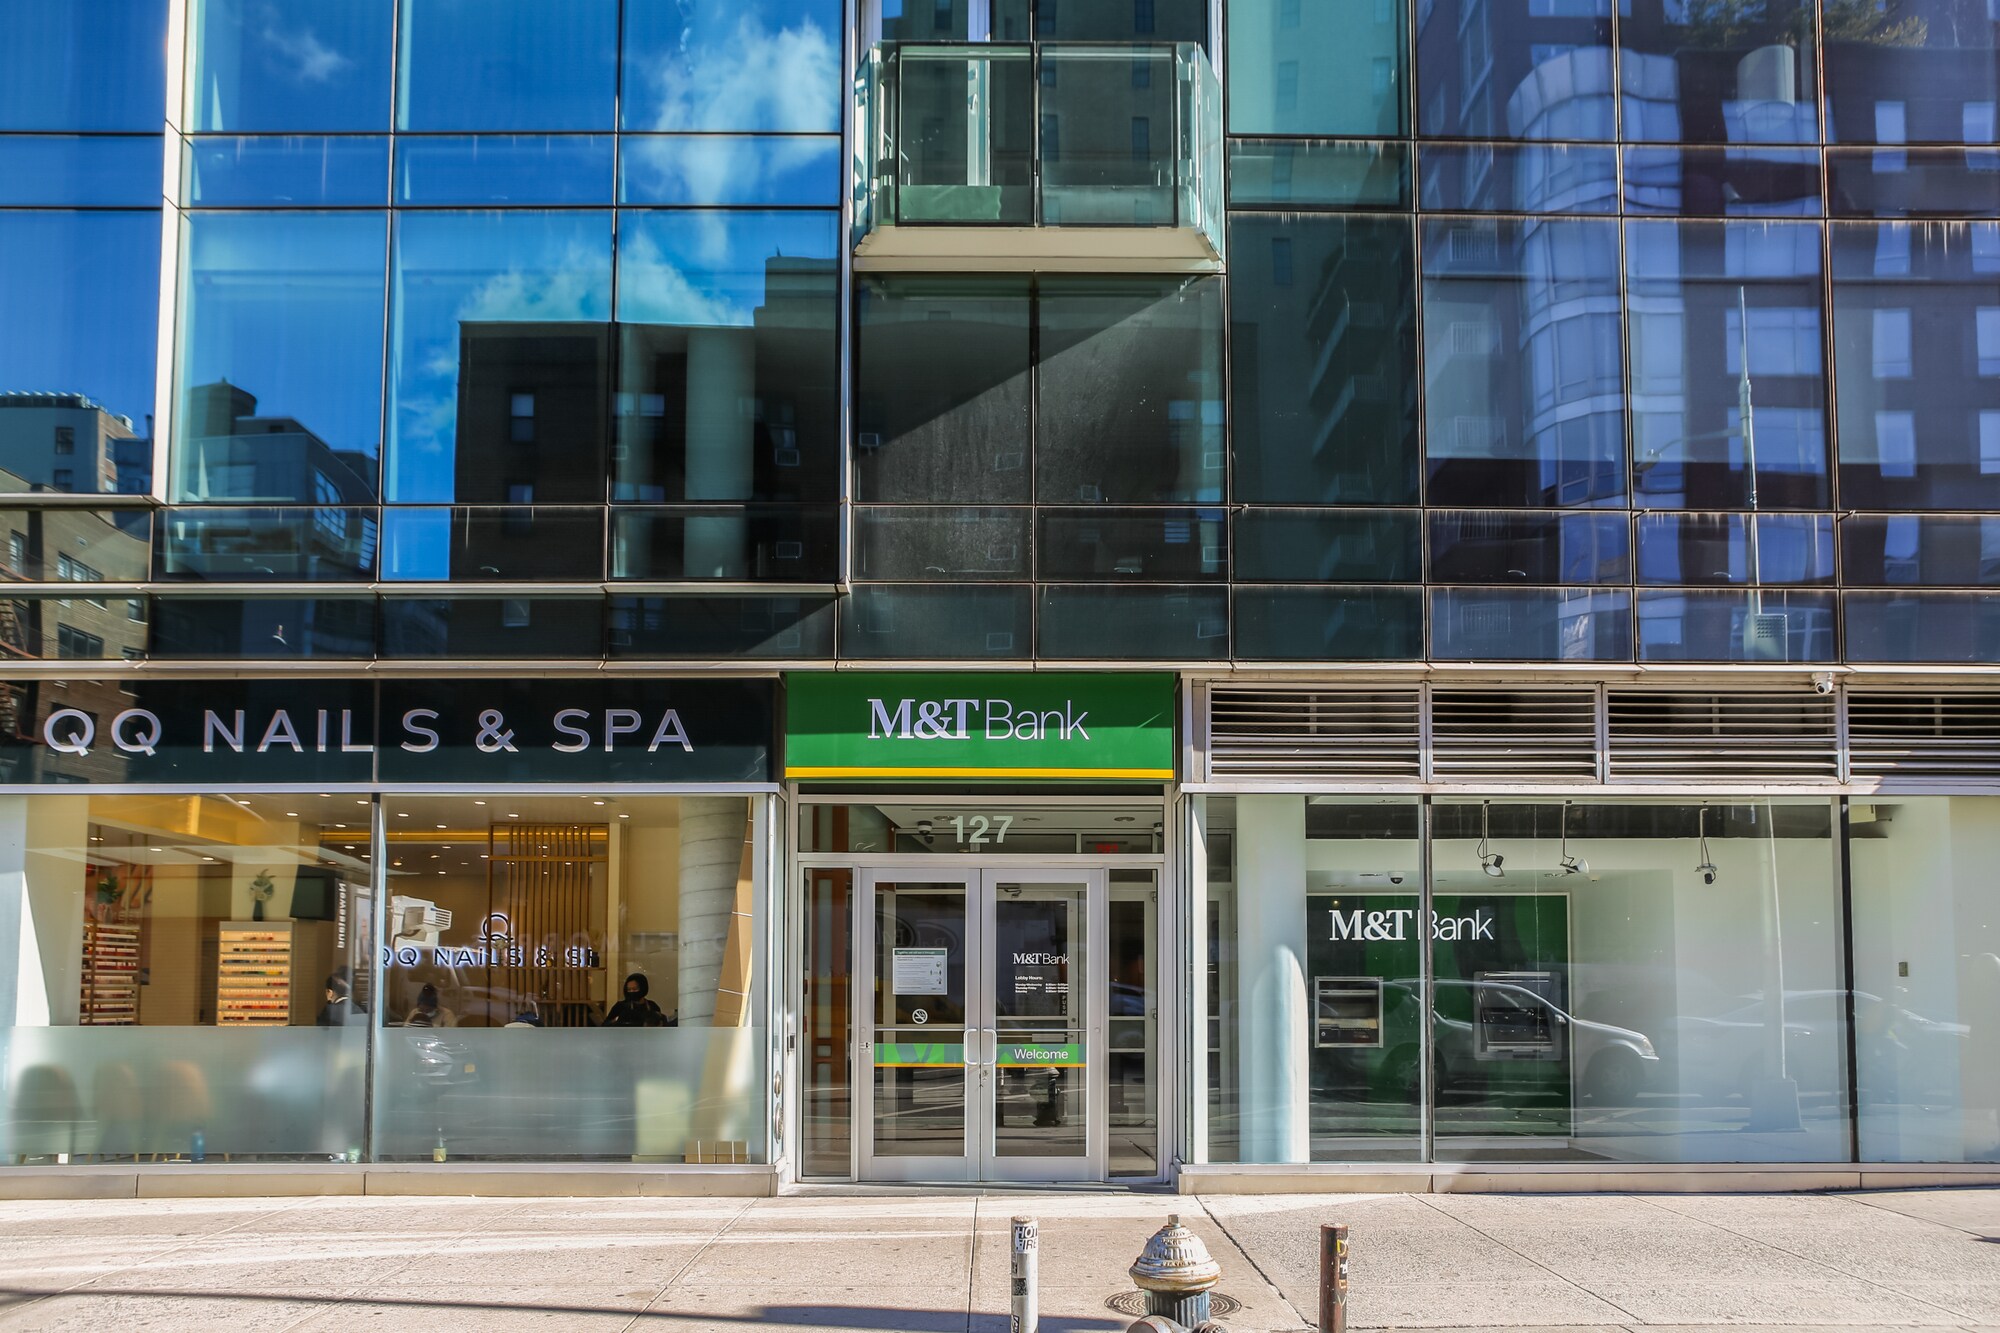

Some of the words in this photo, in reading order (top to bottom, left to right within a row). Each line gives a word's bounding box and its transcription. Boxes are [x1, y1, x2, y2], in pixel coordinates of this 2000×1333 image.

[43, 708, 162, 757] QQ
[203, 708, 440, 753] NAILS
[475, 708, 520, 753] &
[551, 708, 694, 753] SPA
[867, 698, 979, 739] M&T
[985, 700, 1090, 740] Bank
[950, 815, 1014, 843] 127
[1329, 909, 1412, 940] M&T
[1012, 952, 1042, 964] M&T
[1042, 953, 1070, 965] Bank
[1014, 1048, 1069, 1060] Welcome
